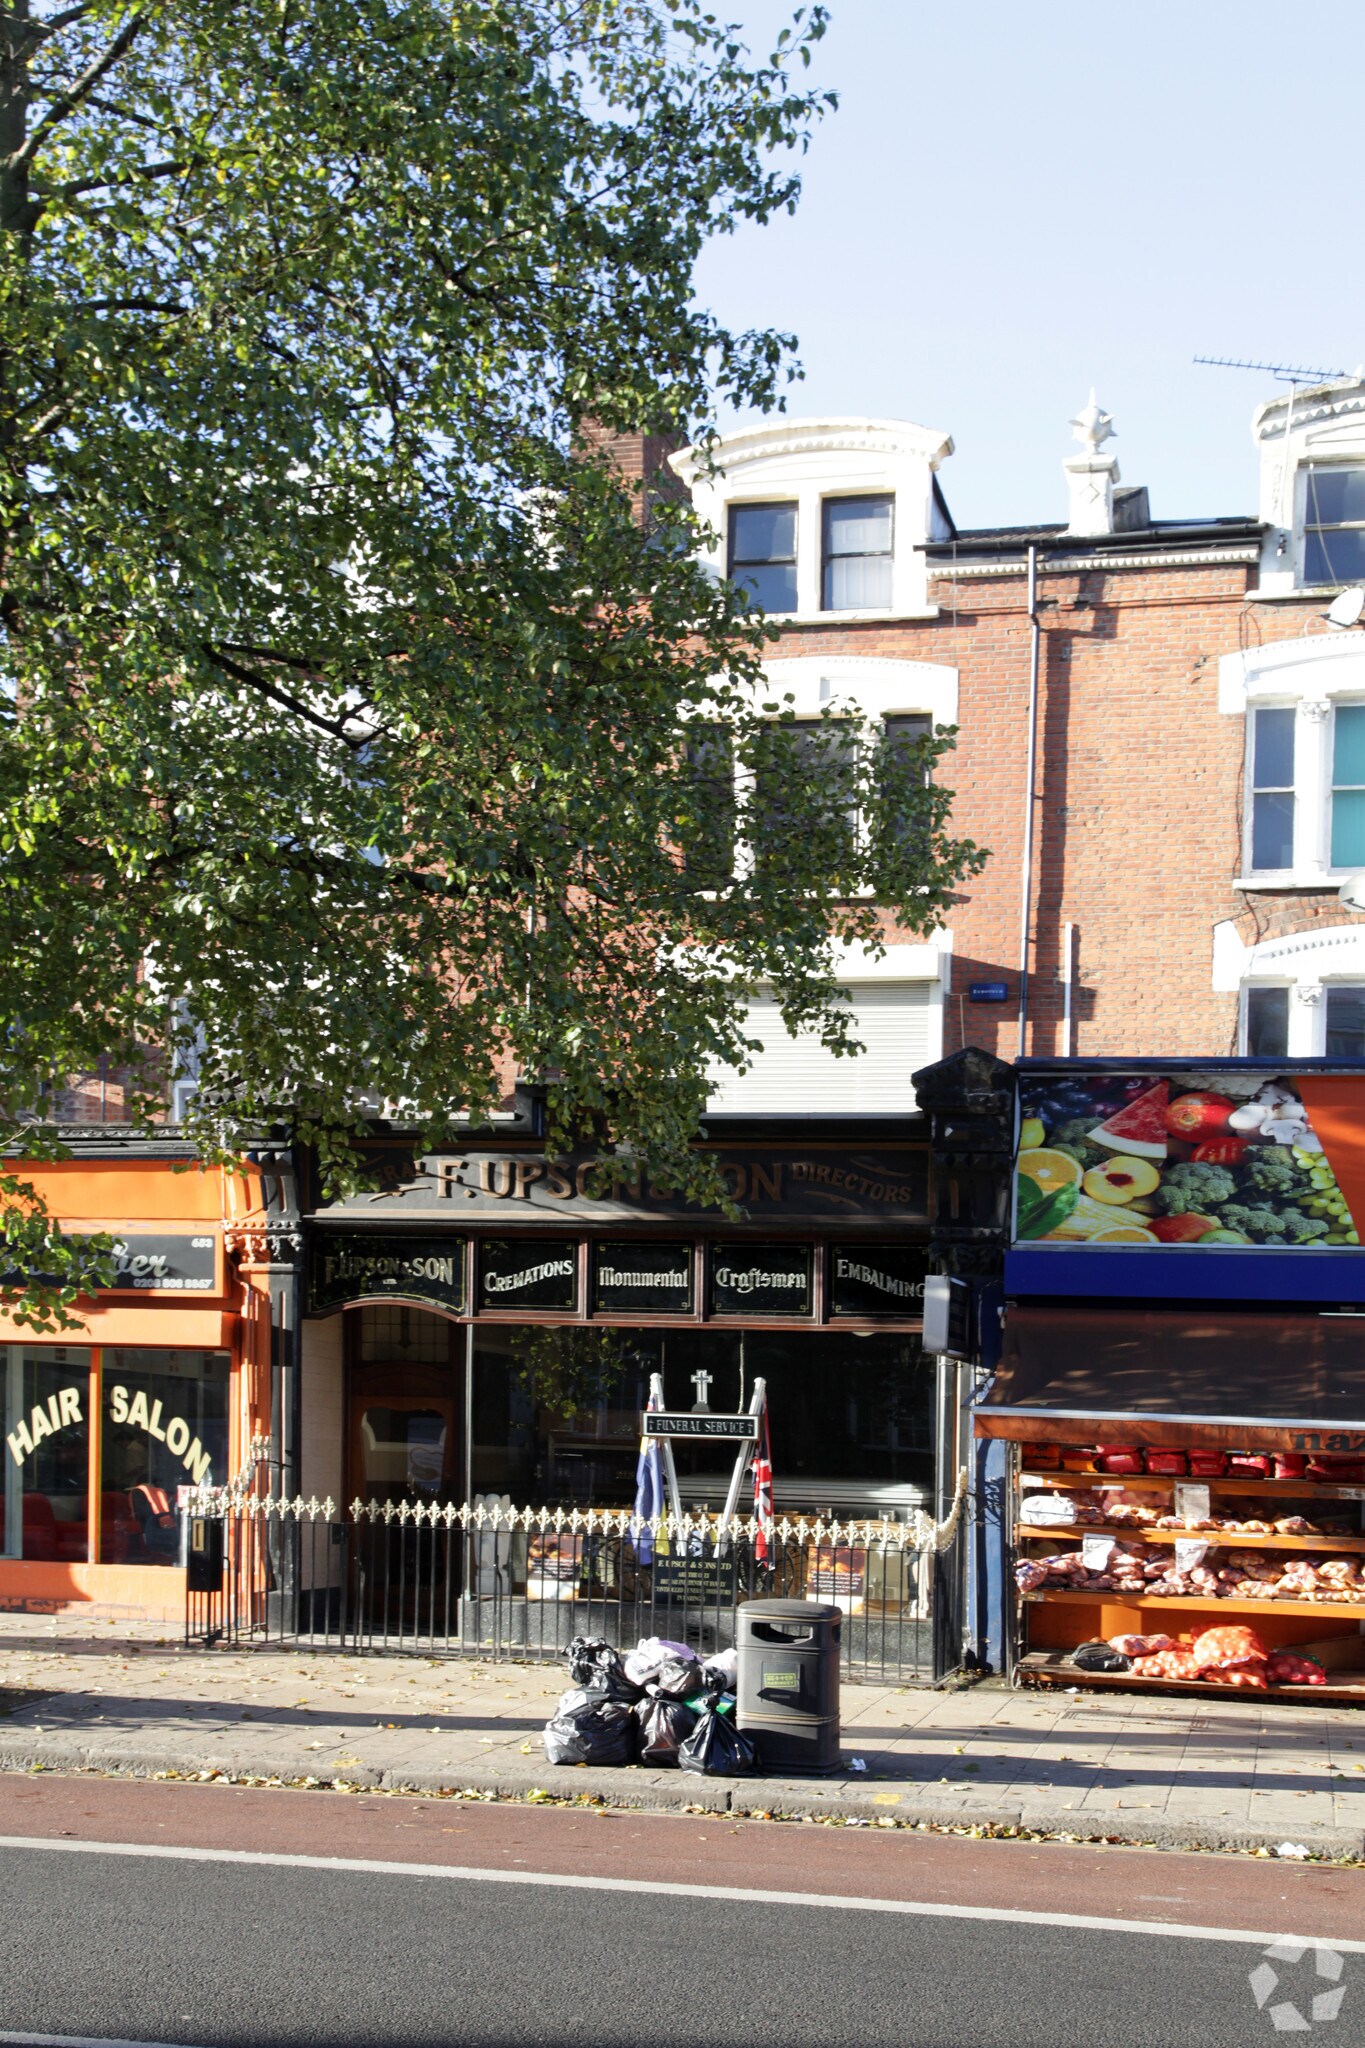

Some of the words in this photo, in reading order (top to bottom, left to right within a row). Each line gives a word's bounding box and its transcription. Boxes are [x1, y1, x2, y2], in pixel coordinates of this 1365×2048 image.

[791, 1161, 913, 1204] DIRECTORS
[484, 1259, 574, 1294] CREMATIONS
[599, 1266, 689, 1288] Monumental
[714, 1266, 808, 1294] Craftsmen
[836, 1259, 925, 1300] EMBALMING
[6, 1386, 84, 1467] HAIR
[109, 1384, 213, 1485] SALON
[656, 1419, 701, 1432] FUNERAL
[704, 1420, 745, 1434] SERVICE
